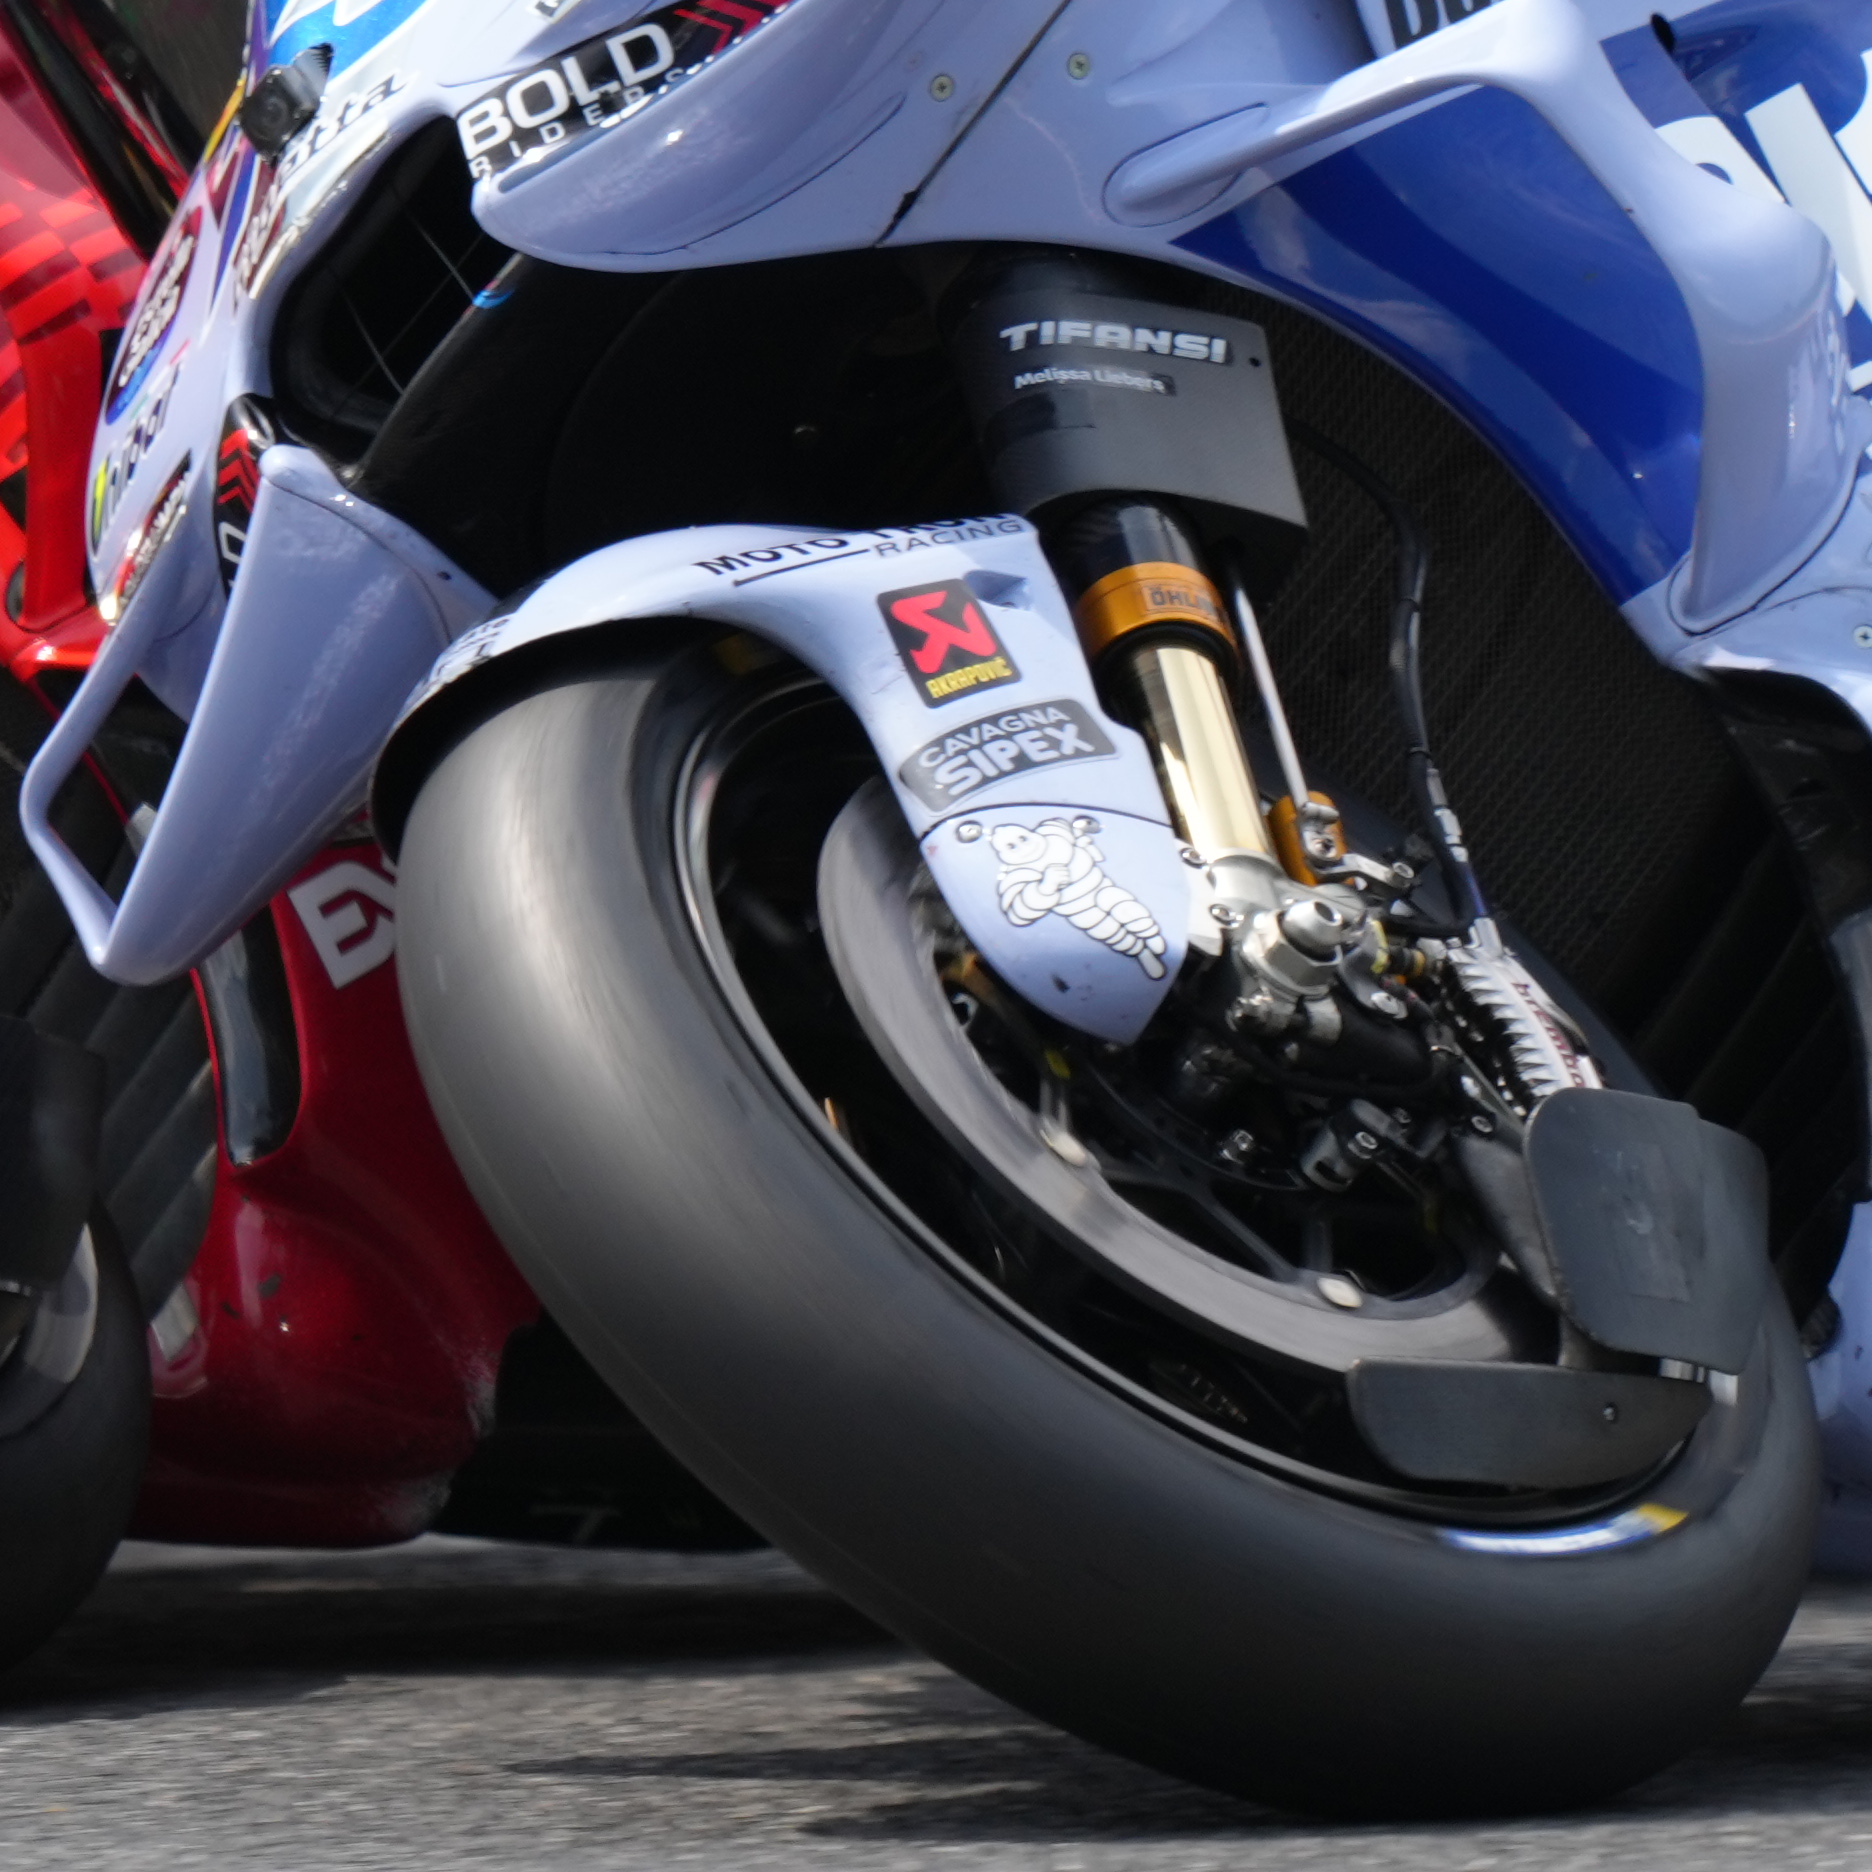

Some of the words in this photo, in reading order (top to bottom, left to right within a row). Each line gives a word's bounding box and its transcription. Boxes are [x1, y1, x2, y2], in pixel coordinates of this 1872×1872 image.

[457, 23, 676, 161] BOLD
[999, 320, 1228, 364] TIFANSI
[874, 518, 1026, 558] RACING
[918, 705, 1071, 770] CAVAGNA
[935, 722, 1096, 798] SIPEX
